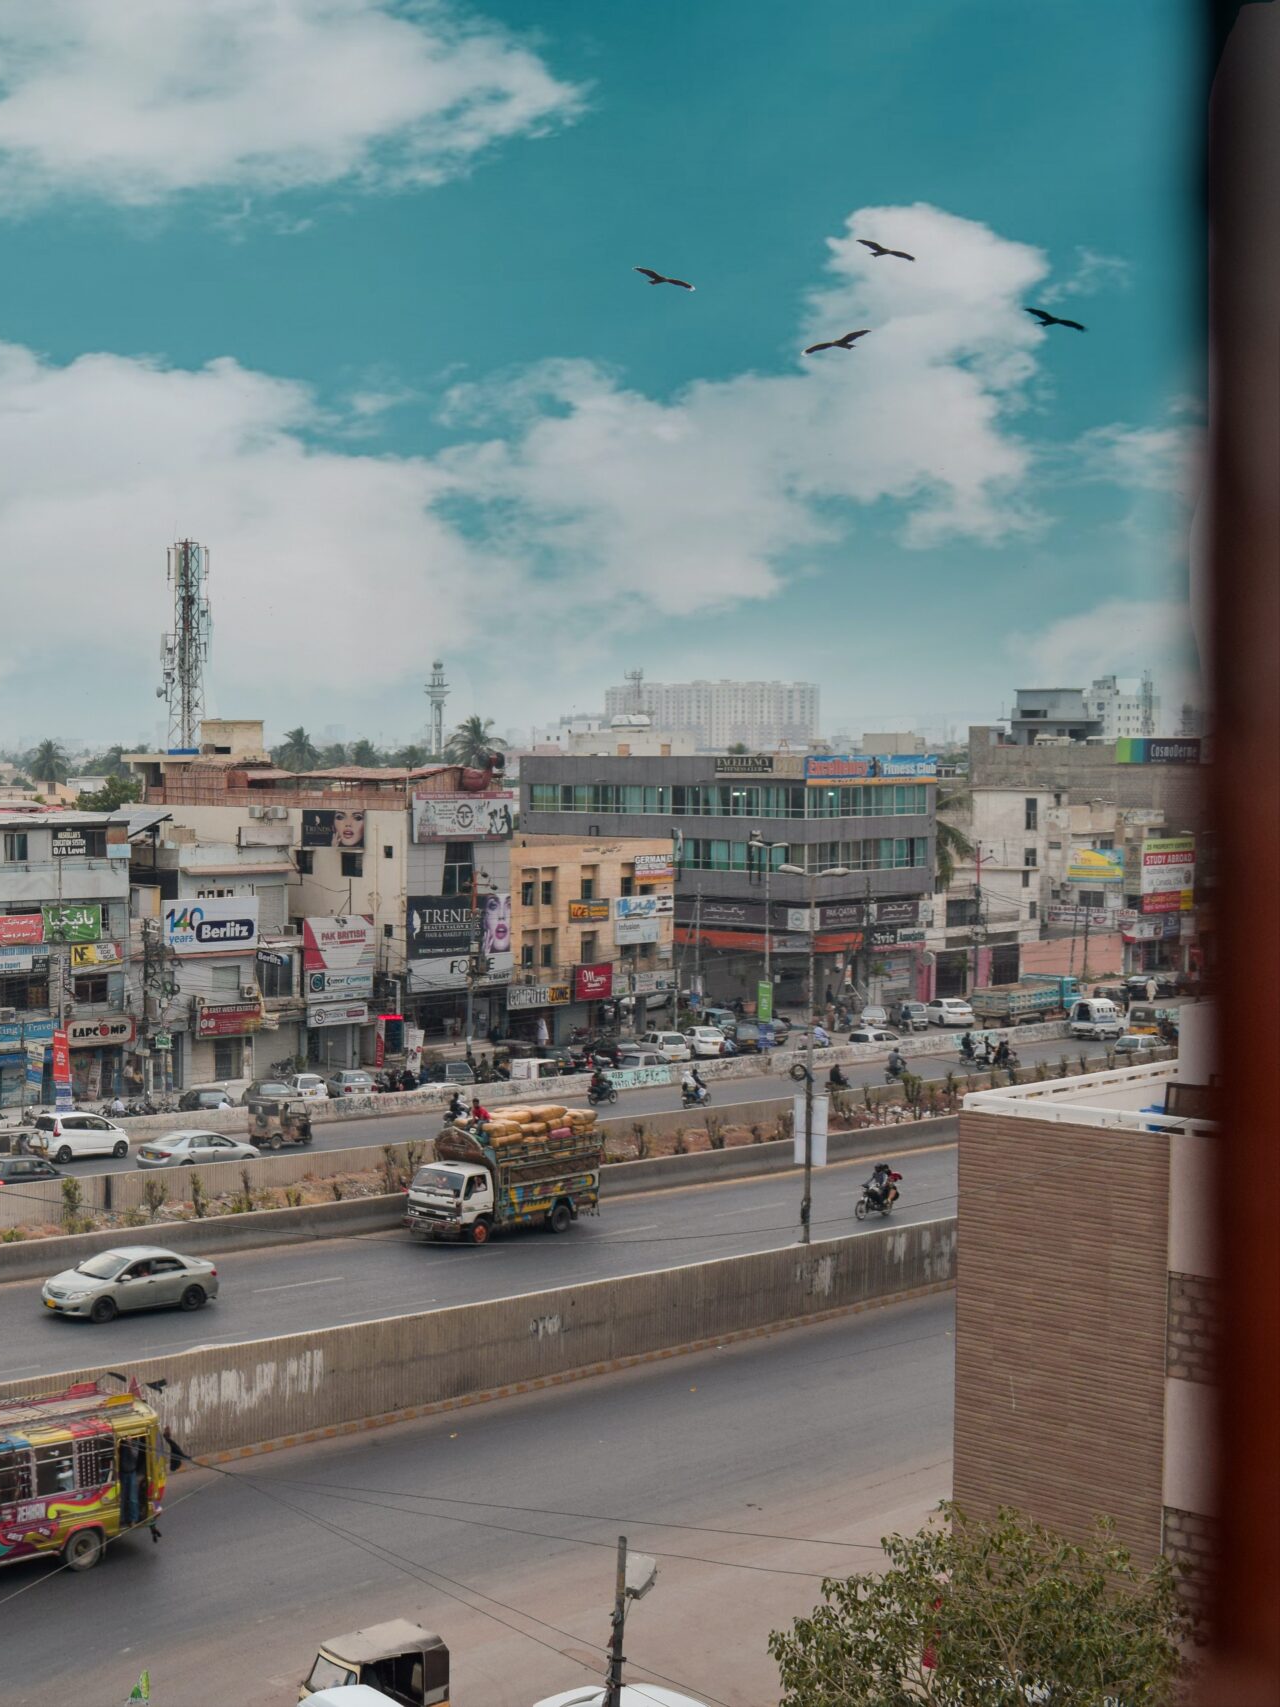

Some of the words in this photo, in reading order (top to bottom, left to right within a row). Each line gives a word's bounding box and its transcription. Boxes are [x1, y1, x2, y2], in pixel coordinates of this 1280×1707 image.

[884, 764, 914, 775] Fitness
[917, 762, 936, 774] Club
[1146, 855, 1166, 864] STUDY
[1168, 854, 1192, 864] ABROAD
[166, 907, 204, 932] 140
[202, 922, 248, 940] Berlitz
[322, 932, 336, 941] PAK
[338, 930, 366, 940] BRITISH
[169, 934, 194, 945] years
[258, 952, 281, 965] Berlitz
[509, 988, 549, 1006] COMPUTER
[550, 988, 569, 1002] ZONE
[27, 1020, 58, 1033] Travels
